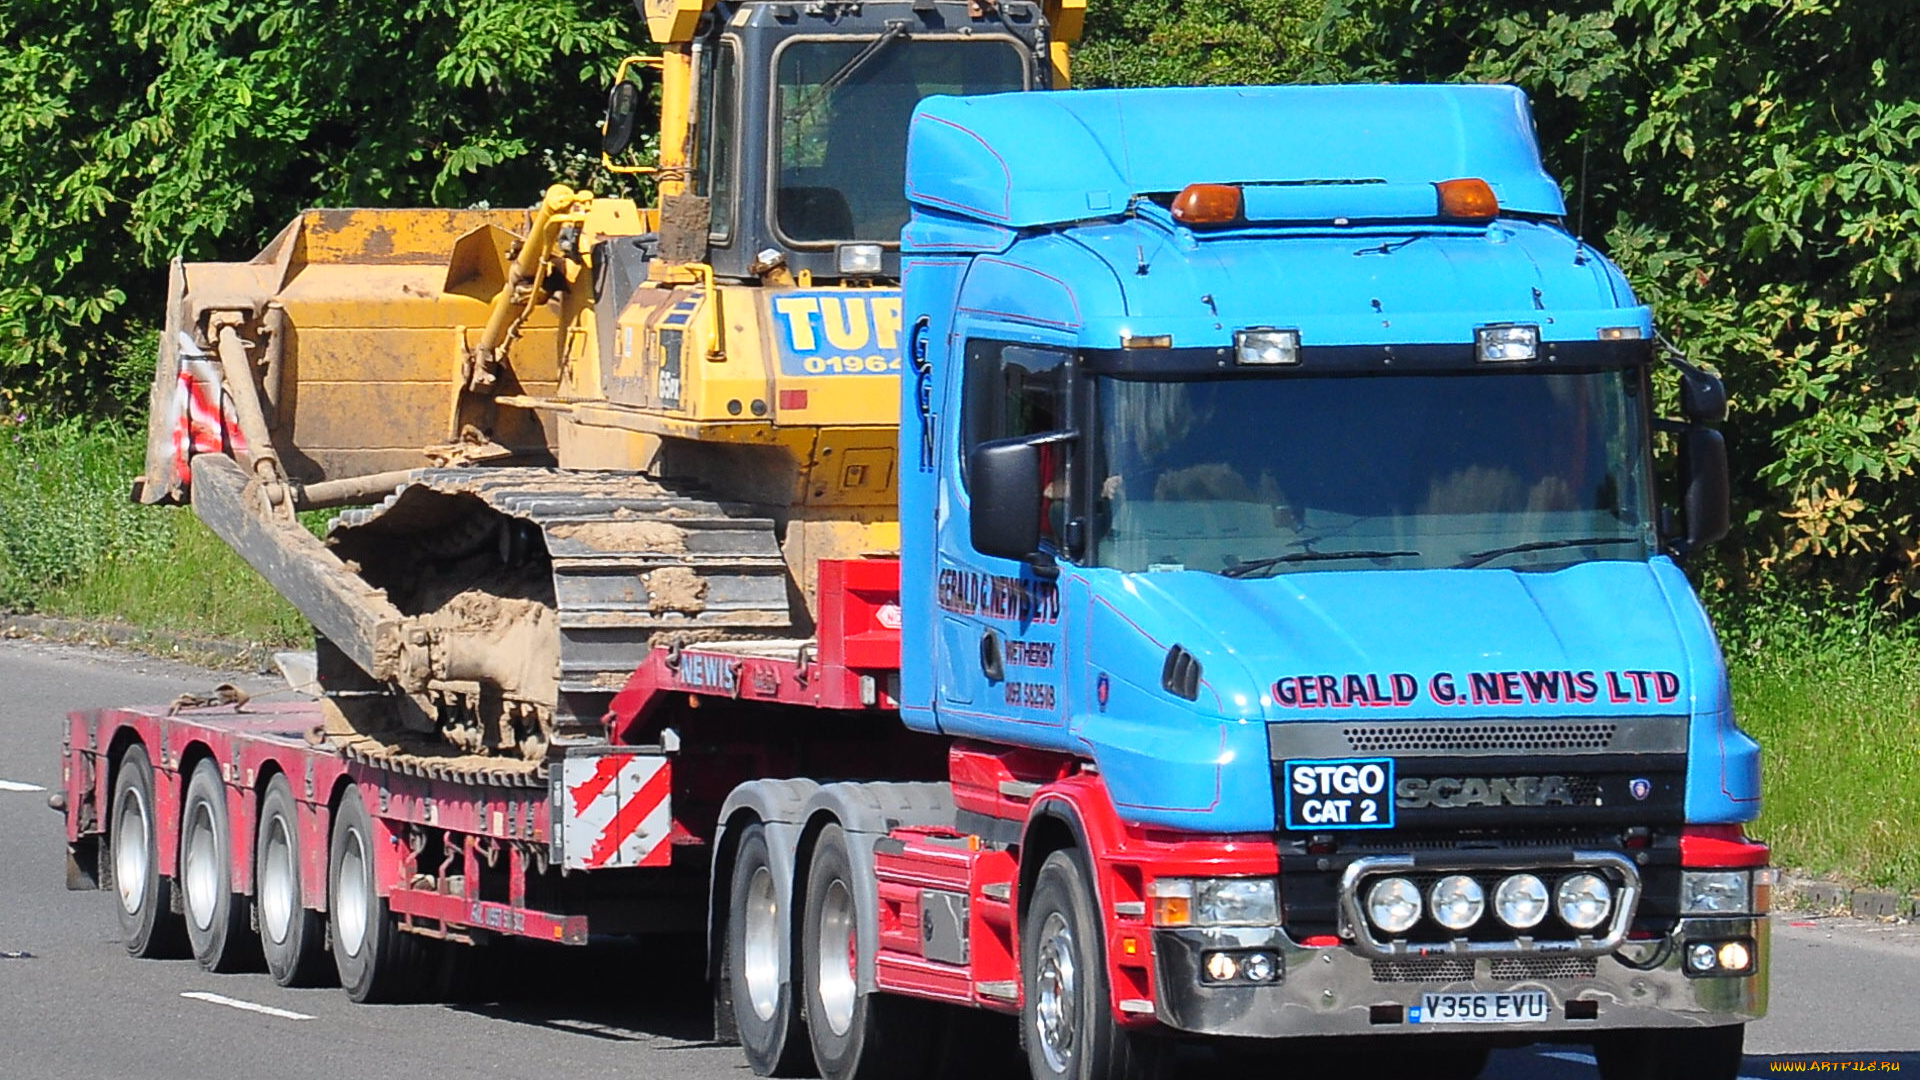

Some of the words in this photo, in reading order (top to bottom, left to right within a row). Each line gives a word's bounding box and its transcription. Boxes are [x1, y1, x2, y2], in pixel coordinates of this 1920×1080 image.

[939, 568, 978, 616] GERALD
[682, 653, 735, 690] NEWIS
[1272, 673, 1419, 708] GERALD
[1605, 670, 1681, 704] LTD
[1293, 764, 1385, 795] STGO
[1396, 775, 1574, 809] SCANIA
[1302, 799, 1351, 823] CAT
[1360, 799, 1378, 823] 2
[1426, 995, 1487, 1018] V356
[1496, 994, 1543, 1018] EVU
